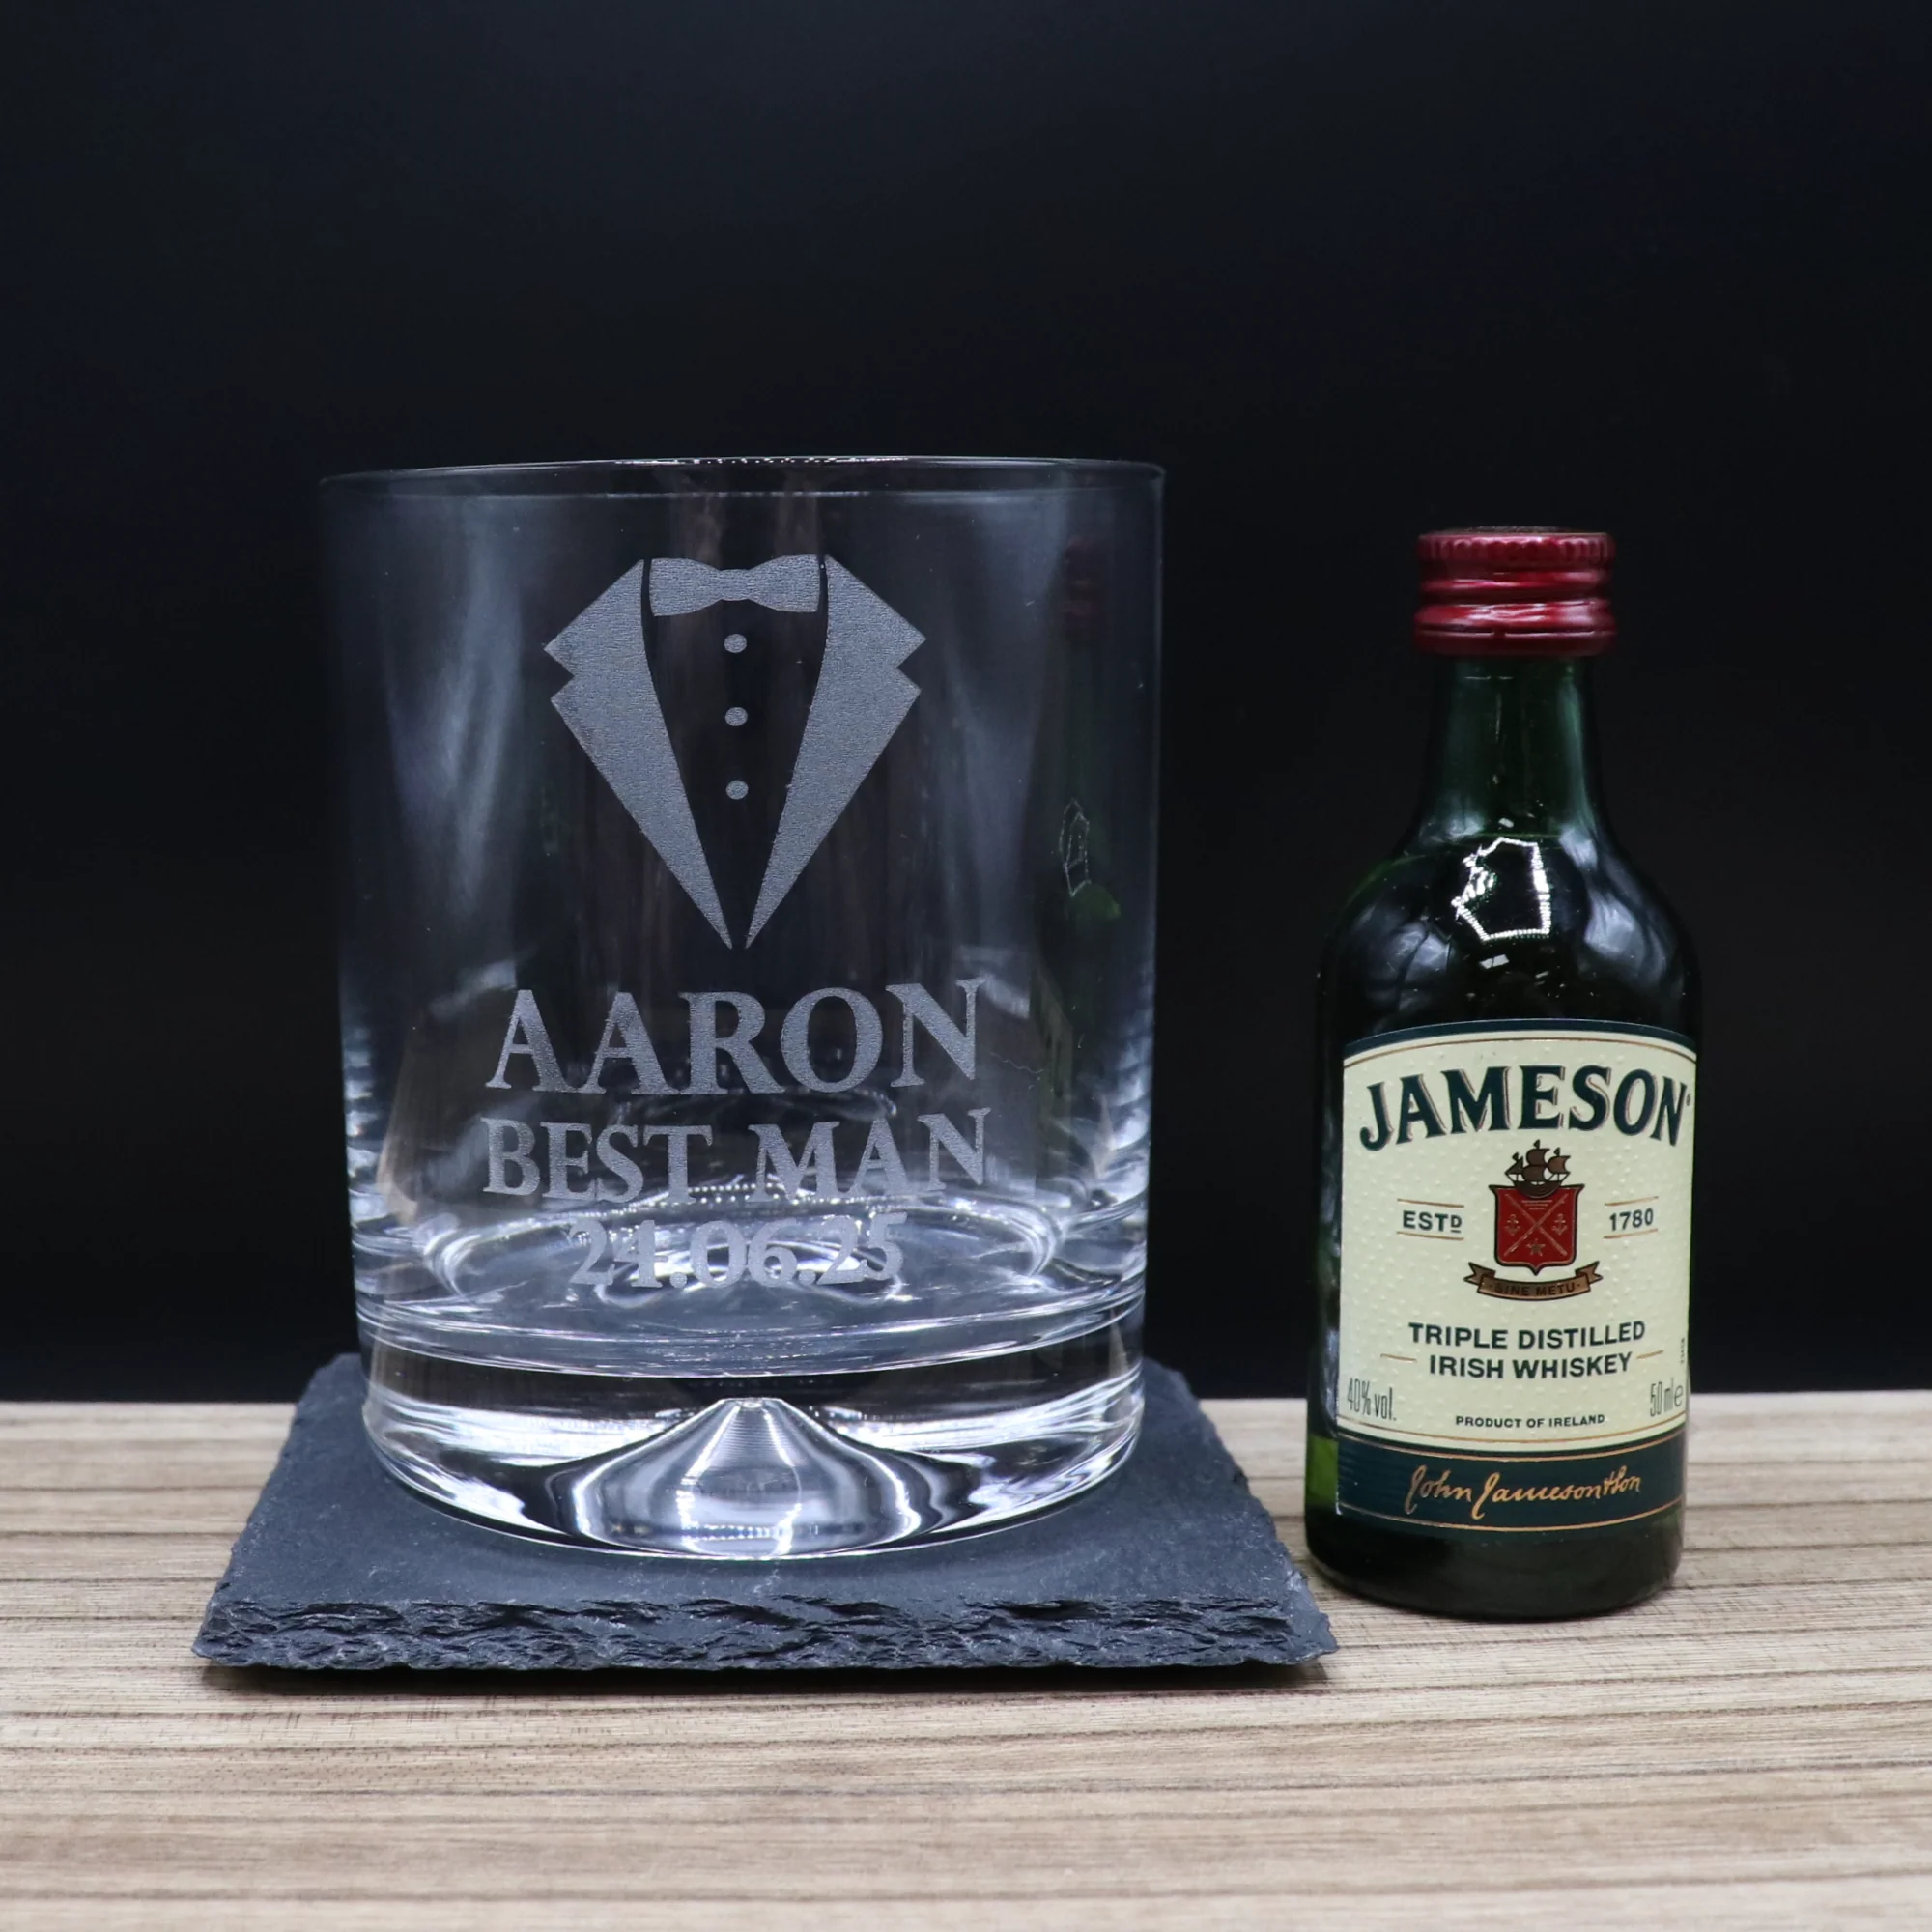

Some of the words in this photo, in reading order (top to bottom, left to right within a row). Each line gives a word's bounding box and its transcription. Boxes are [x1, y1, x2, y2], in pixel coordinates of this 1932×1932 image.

[485, 977, 985, 1095] AARON
[1359, 1065, 1688, 1151] JAMESON
[481, 1117, 713, 1204] BEST
[748, 1108, 991, 1203] MAN
[1609, 1208, 1654, 1232] 1780
[1535, 1282, 1575, 1296] METU
[1408, 1321, 1509, 1349] TRIPLE
[1518, 1320, 1646, 1350] DISTILLED
[1429, 1354, 1504, 1378] IRISH
[1513, 1351, 1633, 1378] WHISKEY
[1347, 1378, 1371, 1416] 40%
[1374, 1386, 1397, 1421] vol.
[1455, 1414, 1520, 1428] PRODUCT
[1526, 1417, 1545, 1429] OF
[1548, 1413, 1605, 1428] IRELAND
